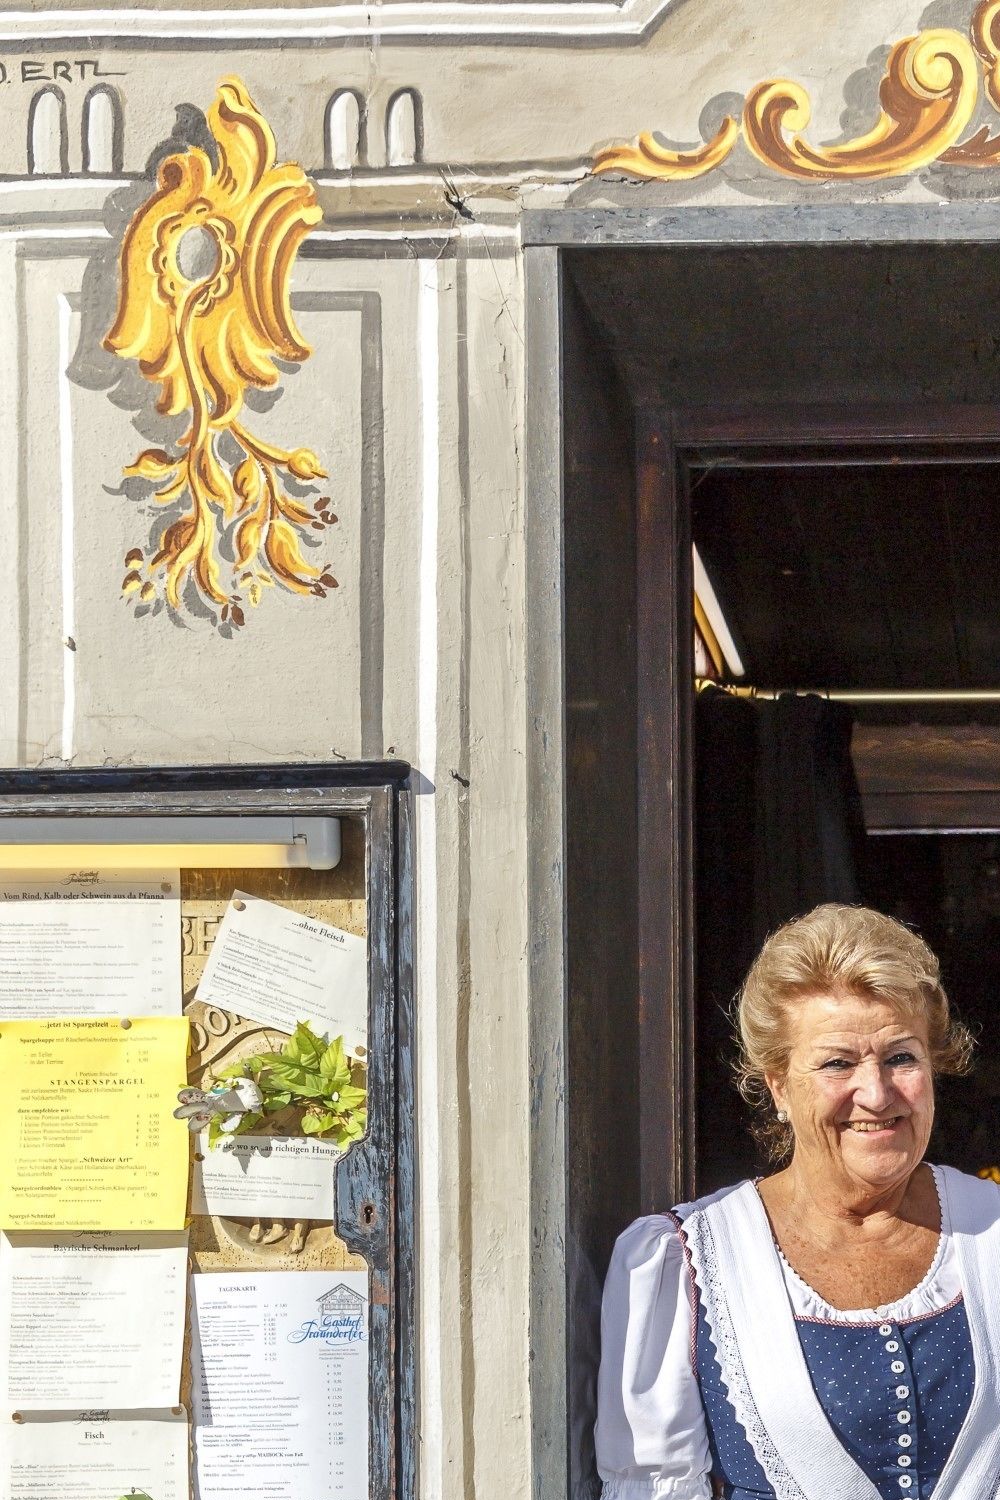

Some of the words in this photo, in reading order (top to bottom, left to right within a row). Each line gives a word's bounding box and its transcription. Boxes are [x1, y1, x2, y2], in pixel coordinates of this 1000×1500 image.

[21, 60, 127, 83] ERTL
[3, 892, 20, 900] Vom
[22, 892, 42, 901] Rind,
[44, 891, 61, 900] Kalb
[63, 891, 80, 900] oder
[81, 891, 111, 900] Schwein
[113, 892, 127, 900] aus
[127, 892, 137, 900] da
[139, 891, 165, 900] Pfanna
[319, 928, 345, 943] Fleisch
[72, 1020, 109, 1029] Spargelzeit
[50, 1078, 145, 1086] STANGENSPARGEL
[275, 1144, 309, 1154] richtigen
[53, 1244, 91, 1253] Bayrische
[93, 1243, 140, 1252] Schmankerl
[320, 1315, 362, 1331] Gasthof
[287, 1319, 368, 1345] Traundorfer
[84, 1431, 105, 1439] Fisch
